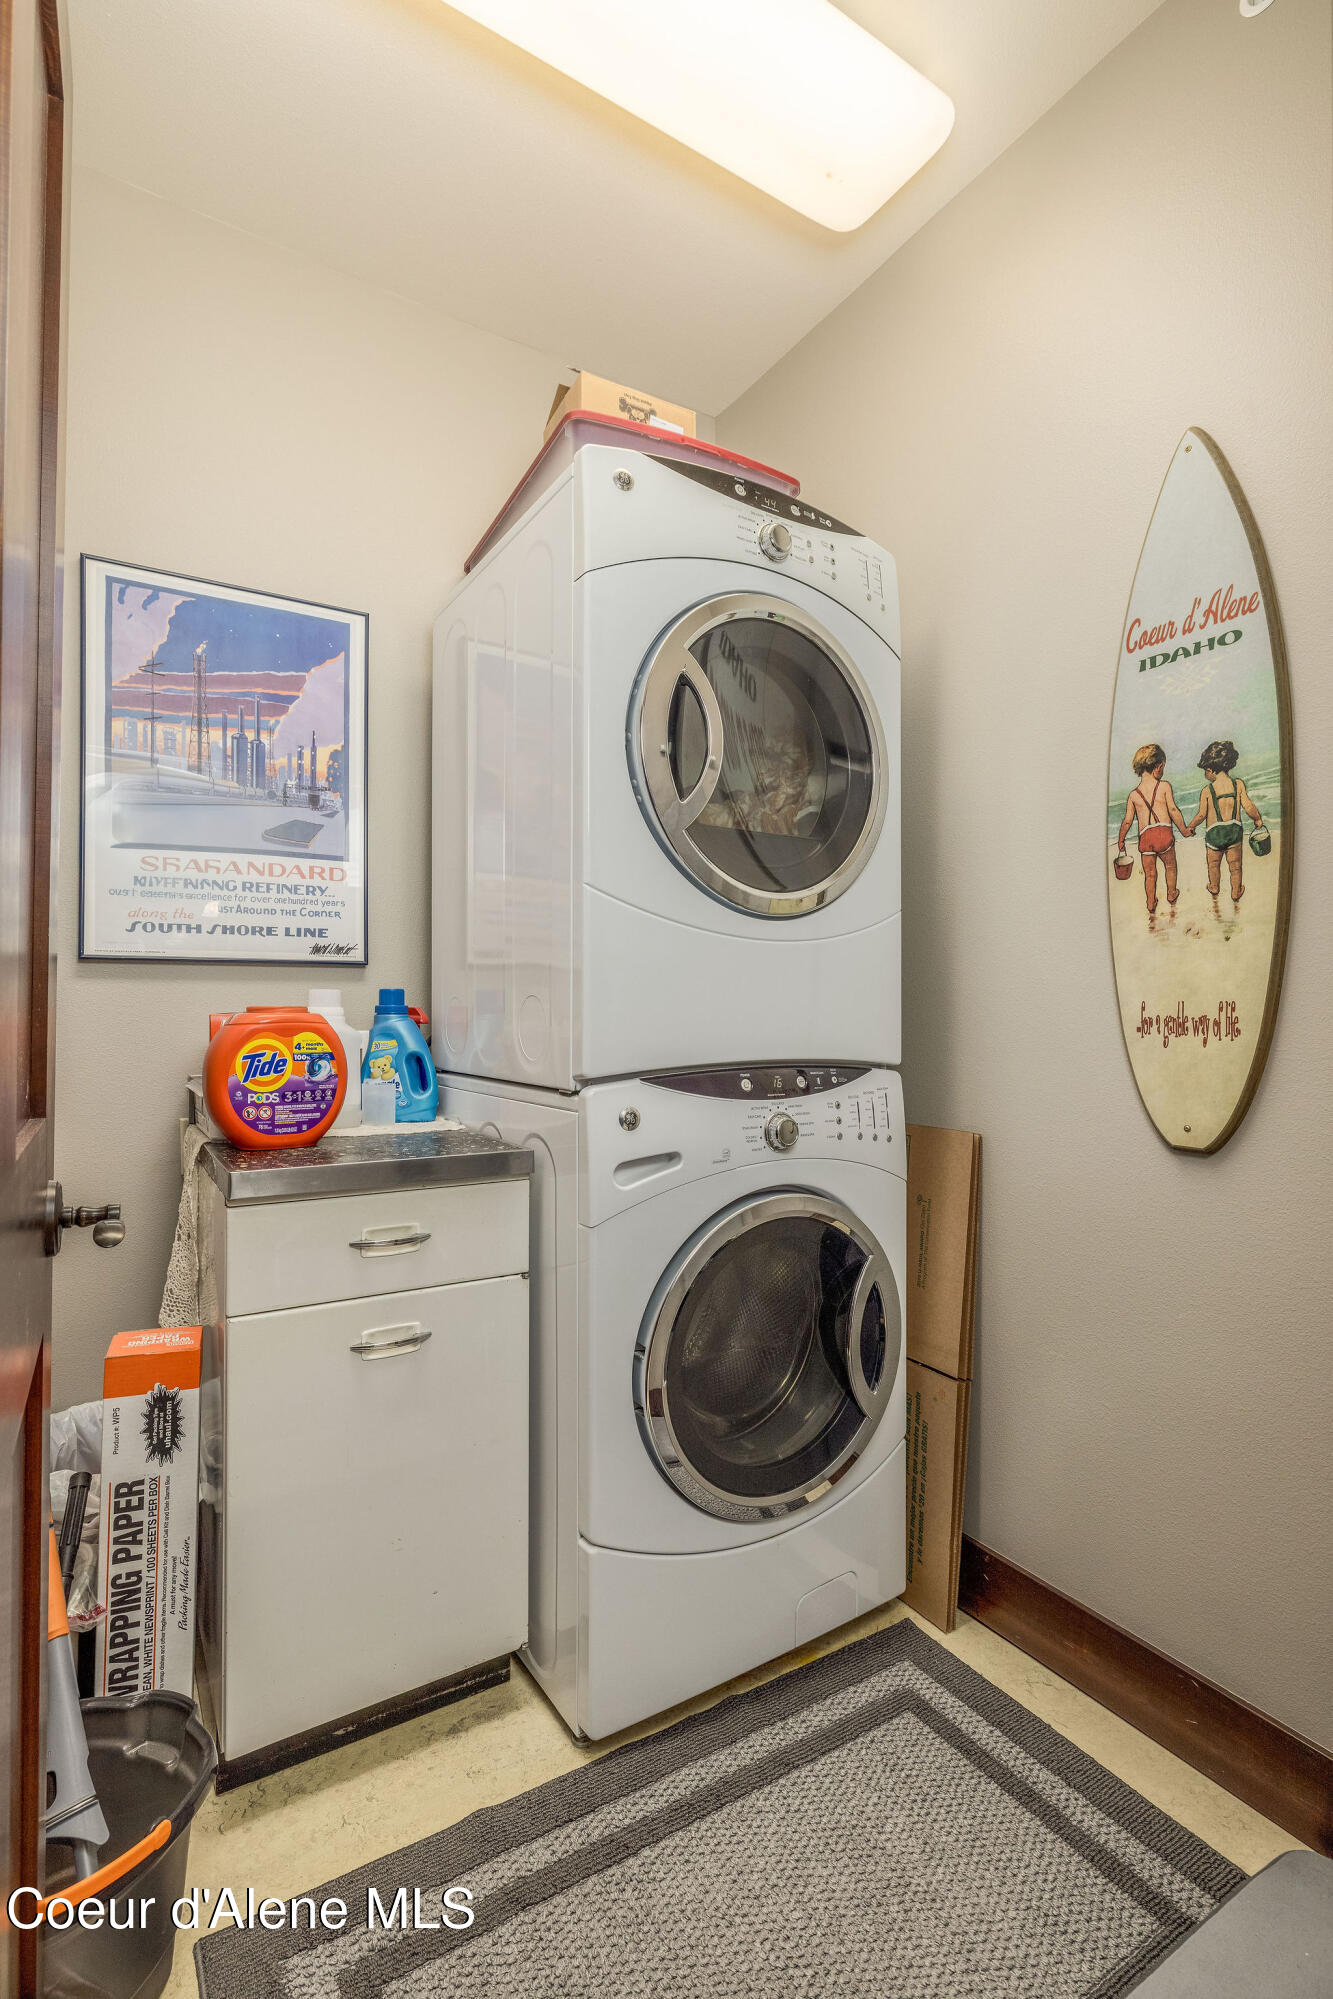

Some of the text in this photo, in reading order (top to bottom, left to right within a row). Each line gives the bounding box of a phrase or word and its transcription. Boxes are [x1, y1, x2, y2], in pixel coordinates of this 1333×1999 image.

[1126, 583, 1260, 654] Coeur d'Alene
[1138, 629, 1243, 673] IDAHO
[127, 906, 194, 921] along the
[234, 894, 248, 902] for
[321, 899, 346, 908] years
[125, 920, 329, 938] SOUTH SHORE LINE
[1156, 1014, 1161, 1035] a
[1163, 1001, 1189, 1048] gentle
[1191, 1014, 1210, 1048] way
[1213, 1001, 1224, 1041] of
[241, 1051, 288, 1084] Tide
[247, 1093, 280, 1104] PODS
[112, 1407, 121, 1425] WP5
[164, 1400, 172, 1448] uhaul.com
[112, 1432, 120, 1455] Product
[148, 1476, 158, 1496] BOX
[111, 1478, 145, 1565] PAPER
[148, 1498, 158, 1517] PER
[147, 1520, 157, 1555] SHEETS
[146, 1556, 156, 1573] 100
[177, 1568, 189, 1594] Made
[144, 1581, 155, 1636] NEWSPRINT
[177, 1595, 191, 1631] Packing
[143, 1638, 154, 1669] WHITE
